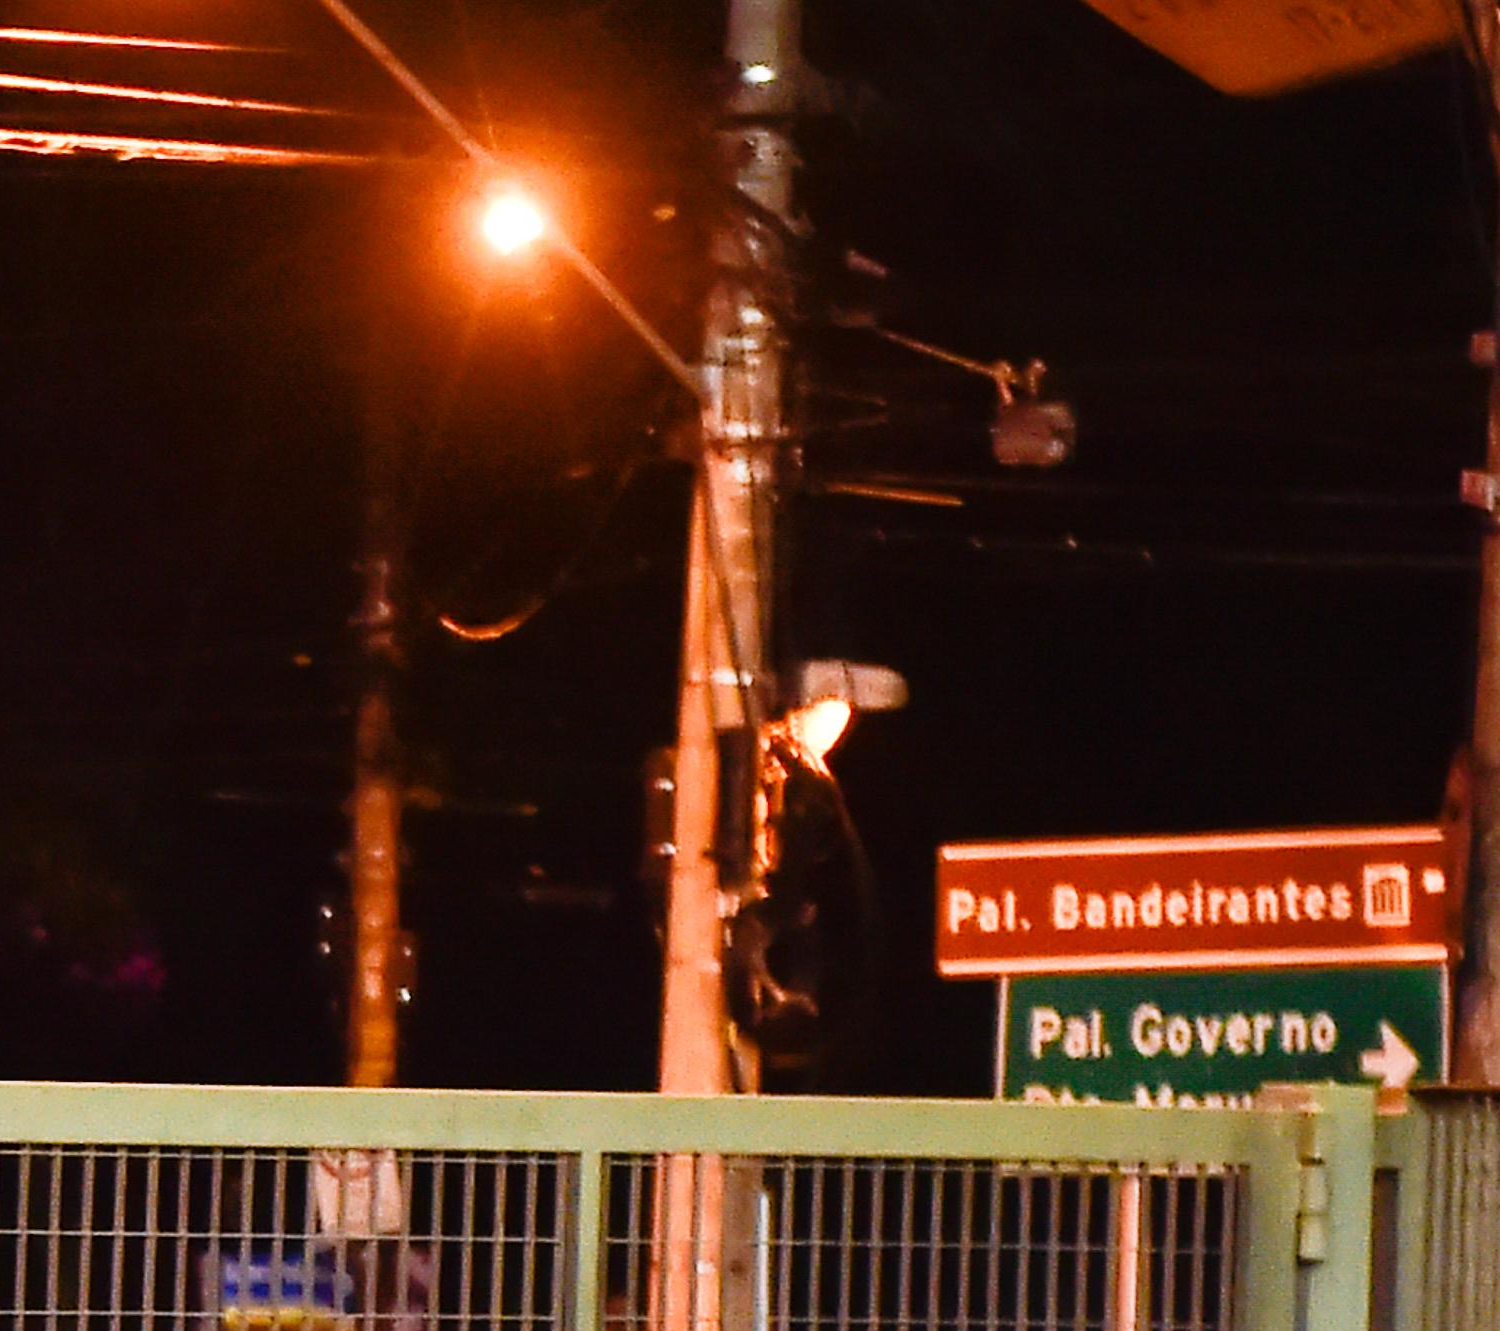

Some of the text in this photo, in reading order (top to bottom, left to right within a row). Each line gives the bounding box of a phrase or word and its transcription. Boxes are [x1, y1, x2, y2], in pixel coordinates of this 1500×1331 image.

[947, 879, 1352, 934] Pal. Bandeirantes
[1030, 1002, 1337, 1059] Pal. Governo
